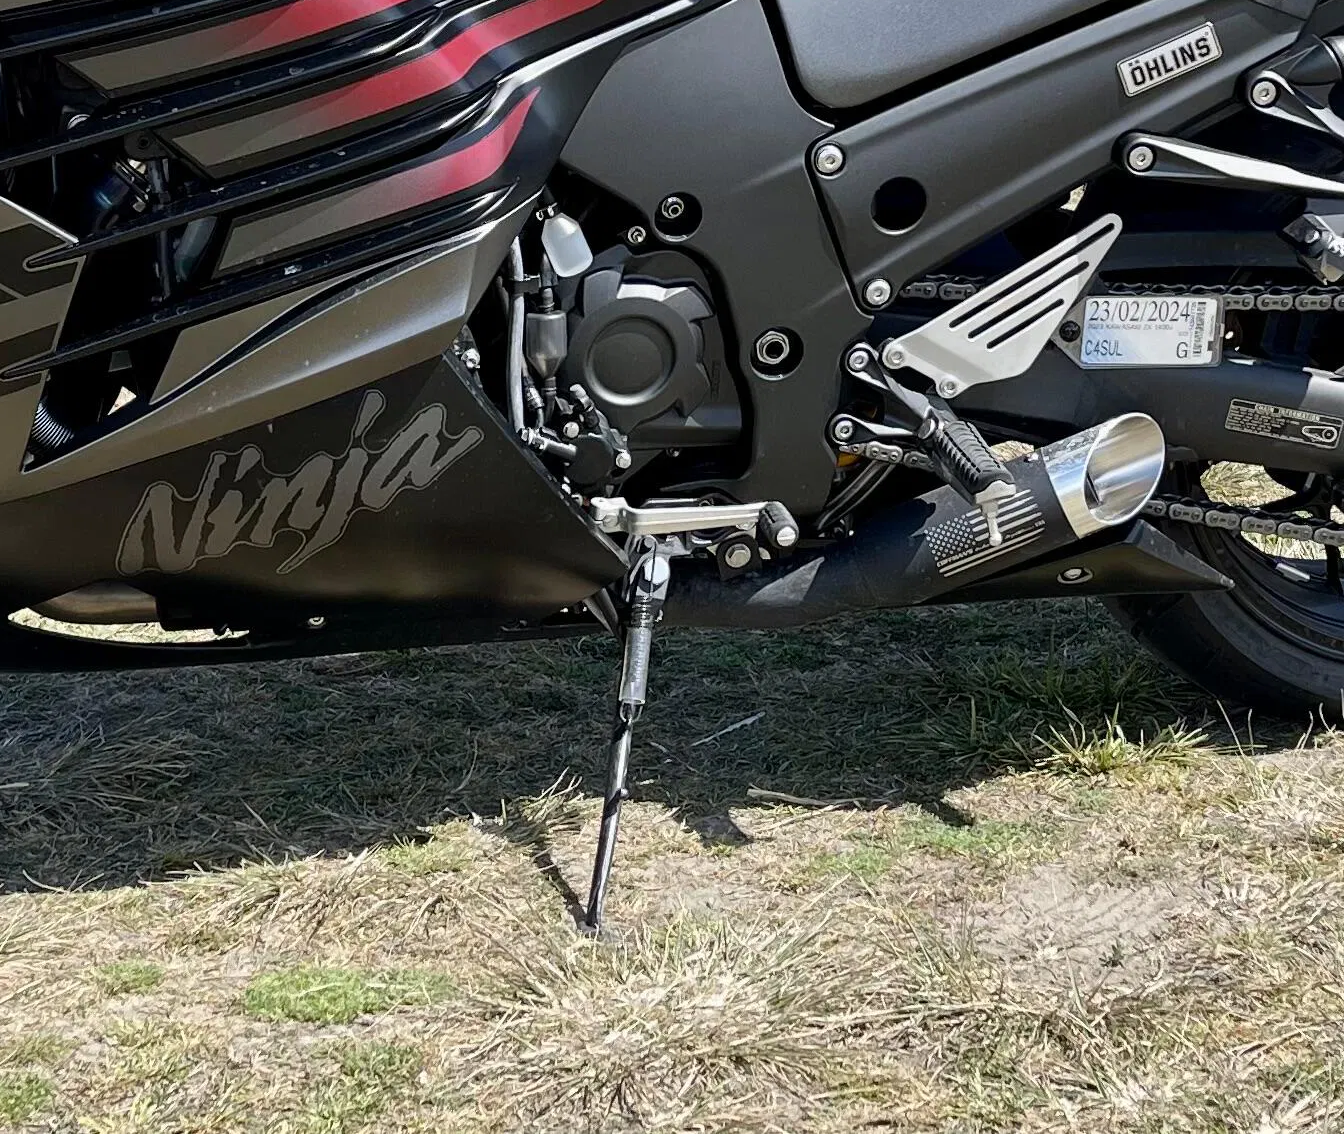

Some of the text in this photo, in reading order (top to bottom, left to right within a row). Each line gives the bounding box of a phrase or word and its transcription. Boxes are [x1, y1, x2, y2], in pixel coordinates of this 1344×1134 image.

[1128, 36, 1211, 86] ÖHLINS
[1089, 300, 1190, 323] 23/02/2024
[1176, 341, 1189, 359] G
[116, 389, 484, 575] Ninja
